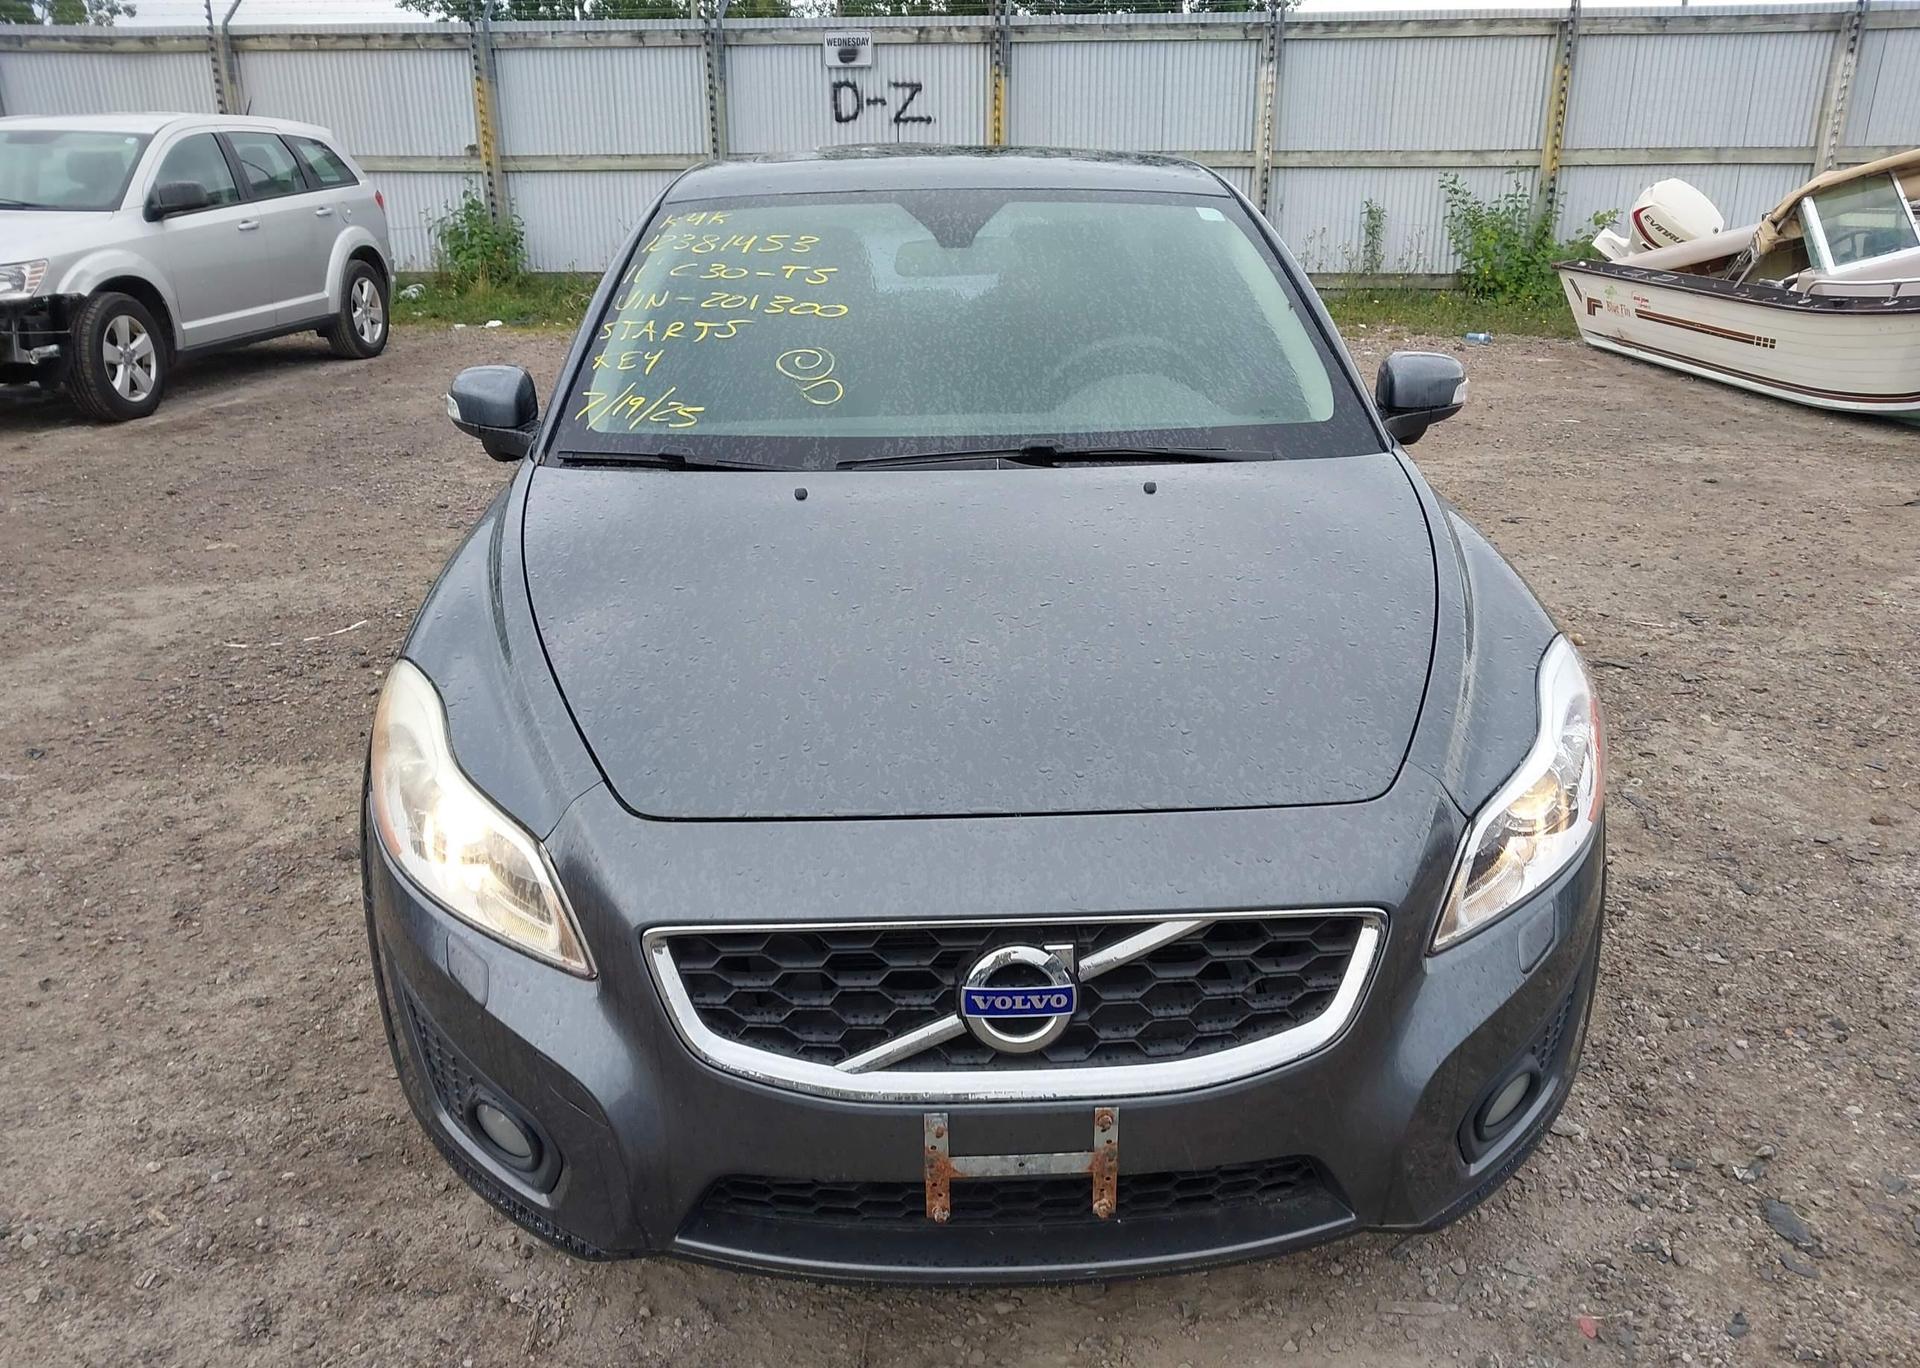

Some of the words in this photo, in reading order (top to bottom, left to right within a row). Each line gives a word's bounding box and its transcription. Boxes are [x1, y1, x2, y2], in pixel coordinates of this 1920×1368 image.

[826, 37, 870, 47] WEDNESDAY
[832, 80, 933, 125] D-Z
[1643, 213, 1687, 244] EVINRU
[599, 319, 755, 343] STARTS
[592, 349, 665, 376] KEY
[971, 993, 1069, 1010] VOLVO
